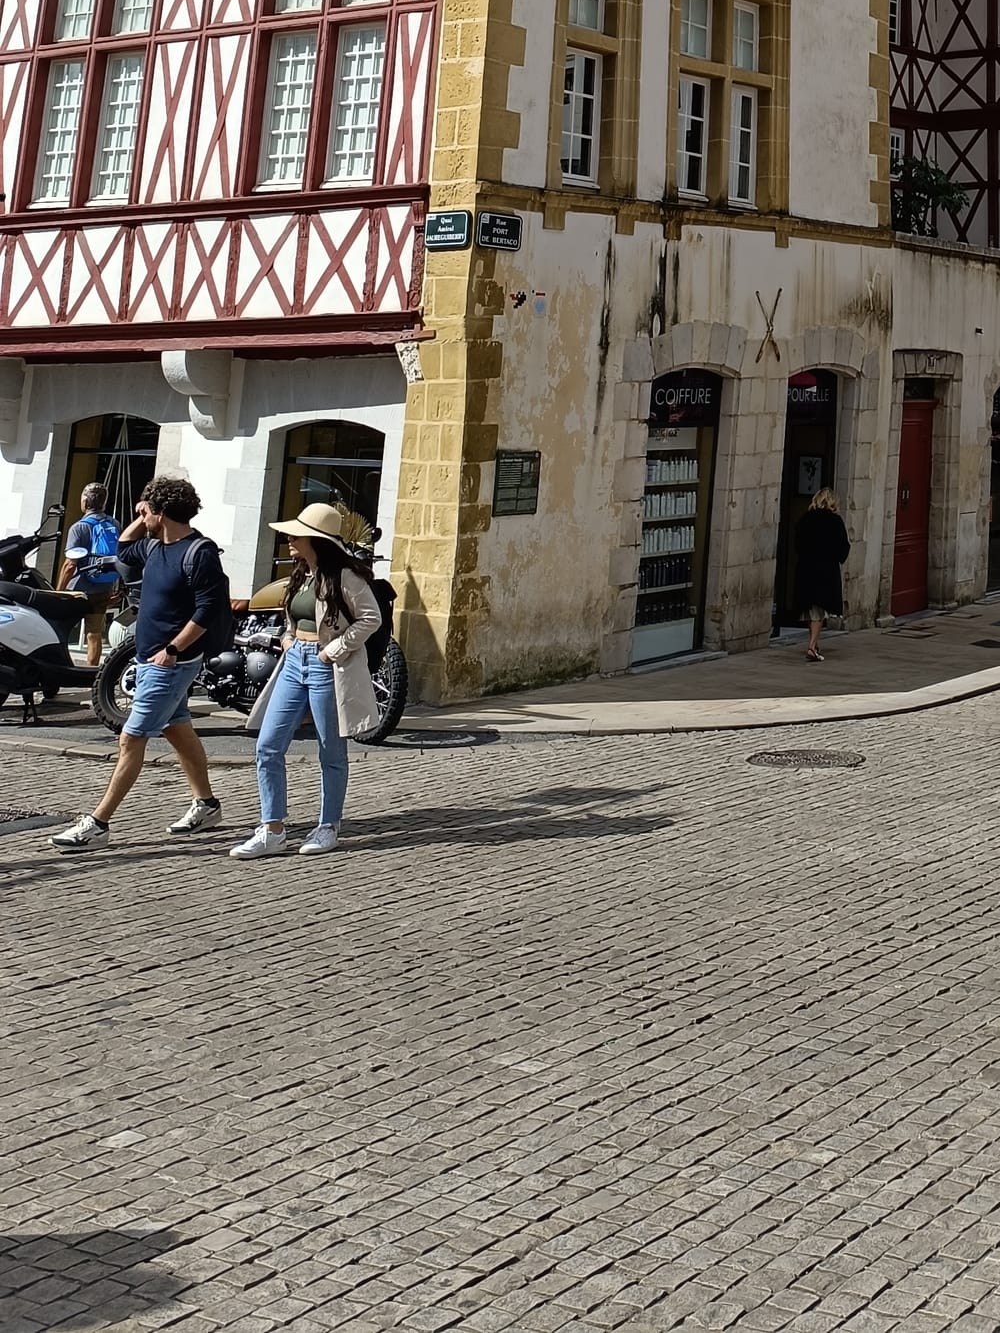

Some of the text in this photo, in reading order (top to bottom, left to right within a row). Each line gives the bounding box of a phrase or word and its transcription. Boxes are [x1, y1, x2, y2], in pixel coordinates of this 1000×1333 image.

[440, 217, 453, 225] Quai
[492, 227, 509, 235] PORT
[481, 235, 490, 243] DE
[655, 388, 712, 406] COIFFURE
[788, 387, 830, 402] POUR ELLE
